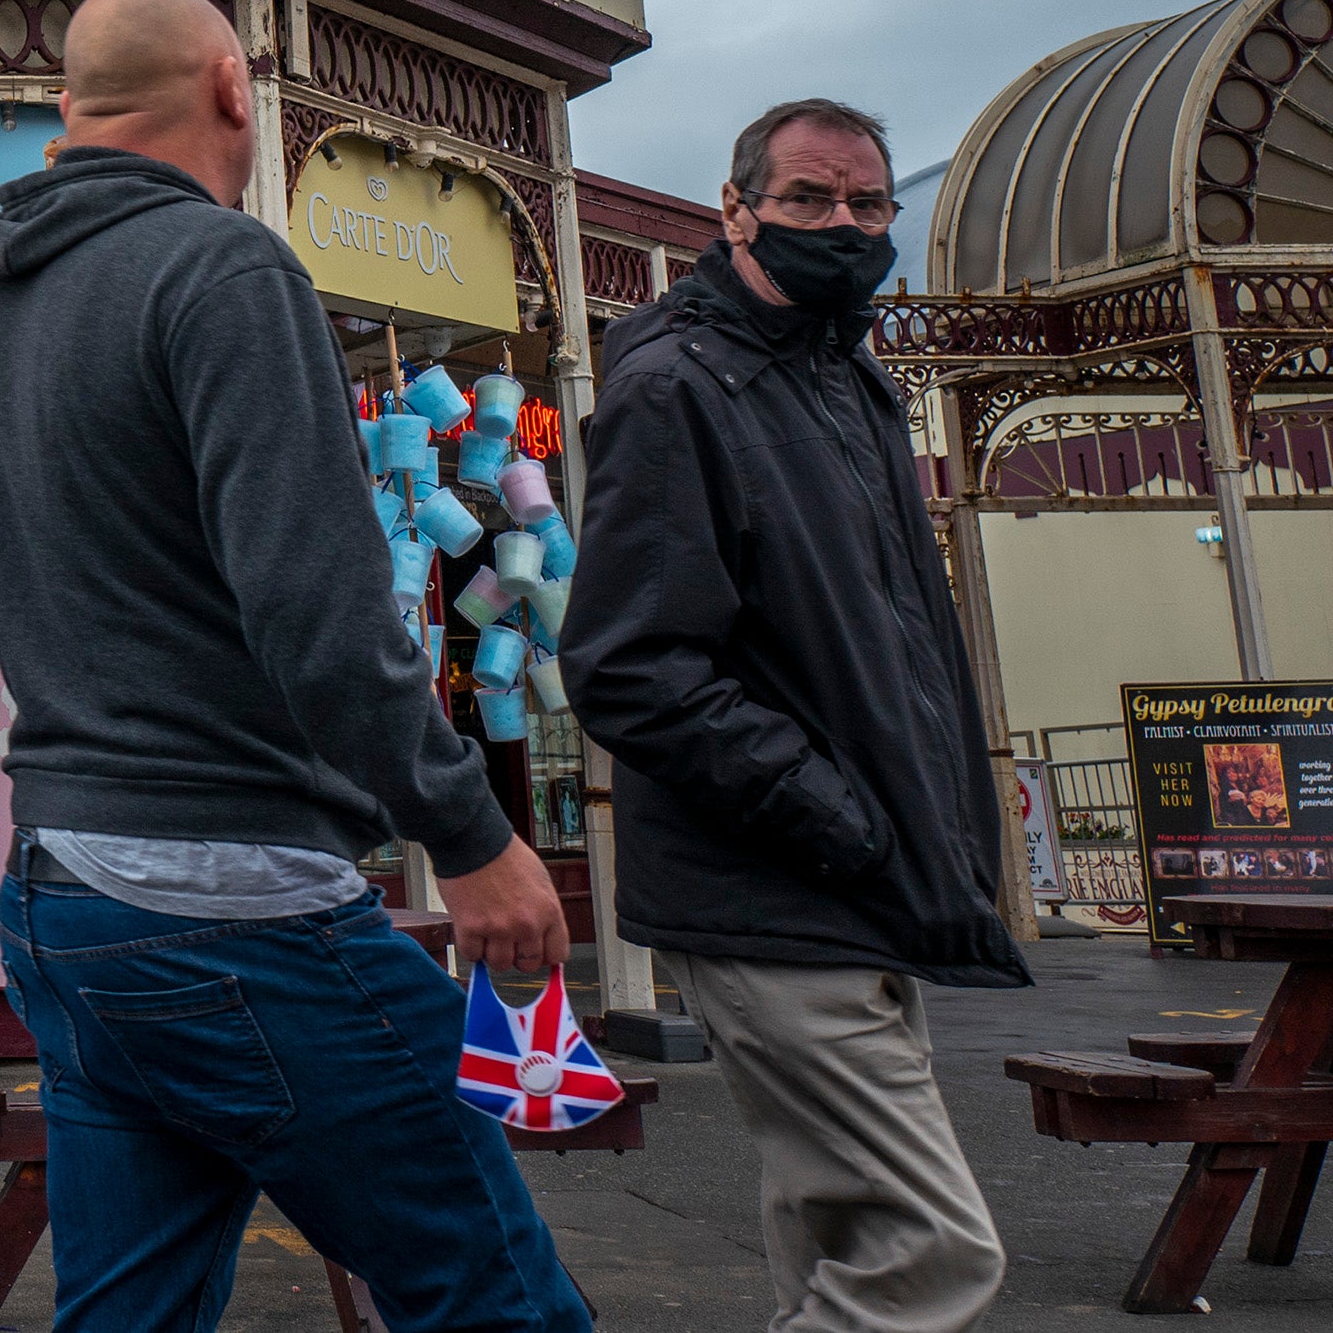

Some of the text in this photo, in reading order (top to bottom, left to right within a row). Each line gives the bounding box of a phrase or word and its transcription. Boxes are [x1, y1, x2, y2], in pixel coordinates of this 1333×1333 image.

[306, 191, 464, 285] CARTE D'OR
[1132, 694, 1207, 721] Gypsy
[1144, 725, 1185, 739] PALMIST
[1193, 724, 1262, 738] CLAIRVOYANT
[1152, 762, 1193, 776] VISIT
[1298, 760, 1331, 772] working
[1161, 778, 1190, 792] HER
[1160, 794, 1193, 807] NOW
[1176, 833, 1200, 842] read
[1201, 833, 1221, 842] and
[1222, 833, 1271, 844] predicted
